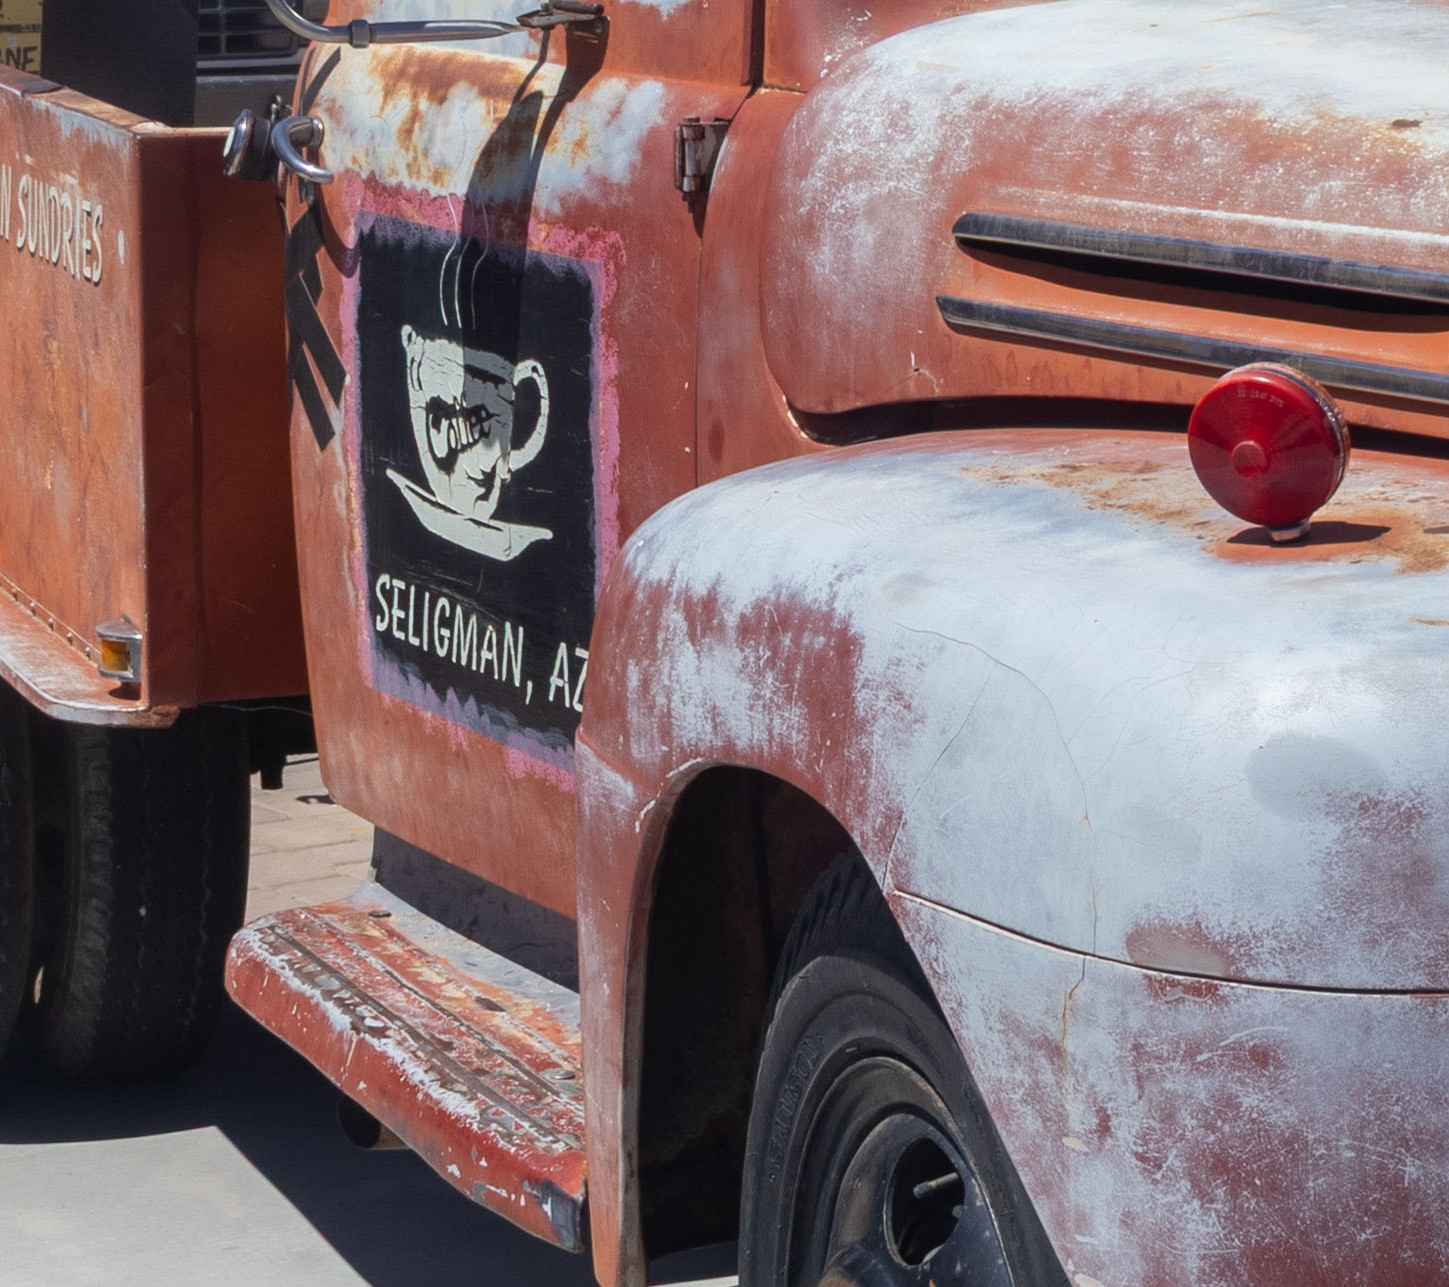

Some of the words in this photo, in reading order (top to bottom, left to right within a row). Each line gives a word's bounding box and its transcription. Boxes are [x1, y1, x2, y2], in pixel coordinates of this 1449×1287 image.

[15, 173, 103, 285] SUNDRIES
[426, 396, 500, 462] Coffee
[375, 572, 534, 707] SELIGMAN,
[549, 646, 588, 713] AZ
